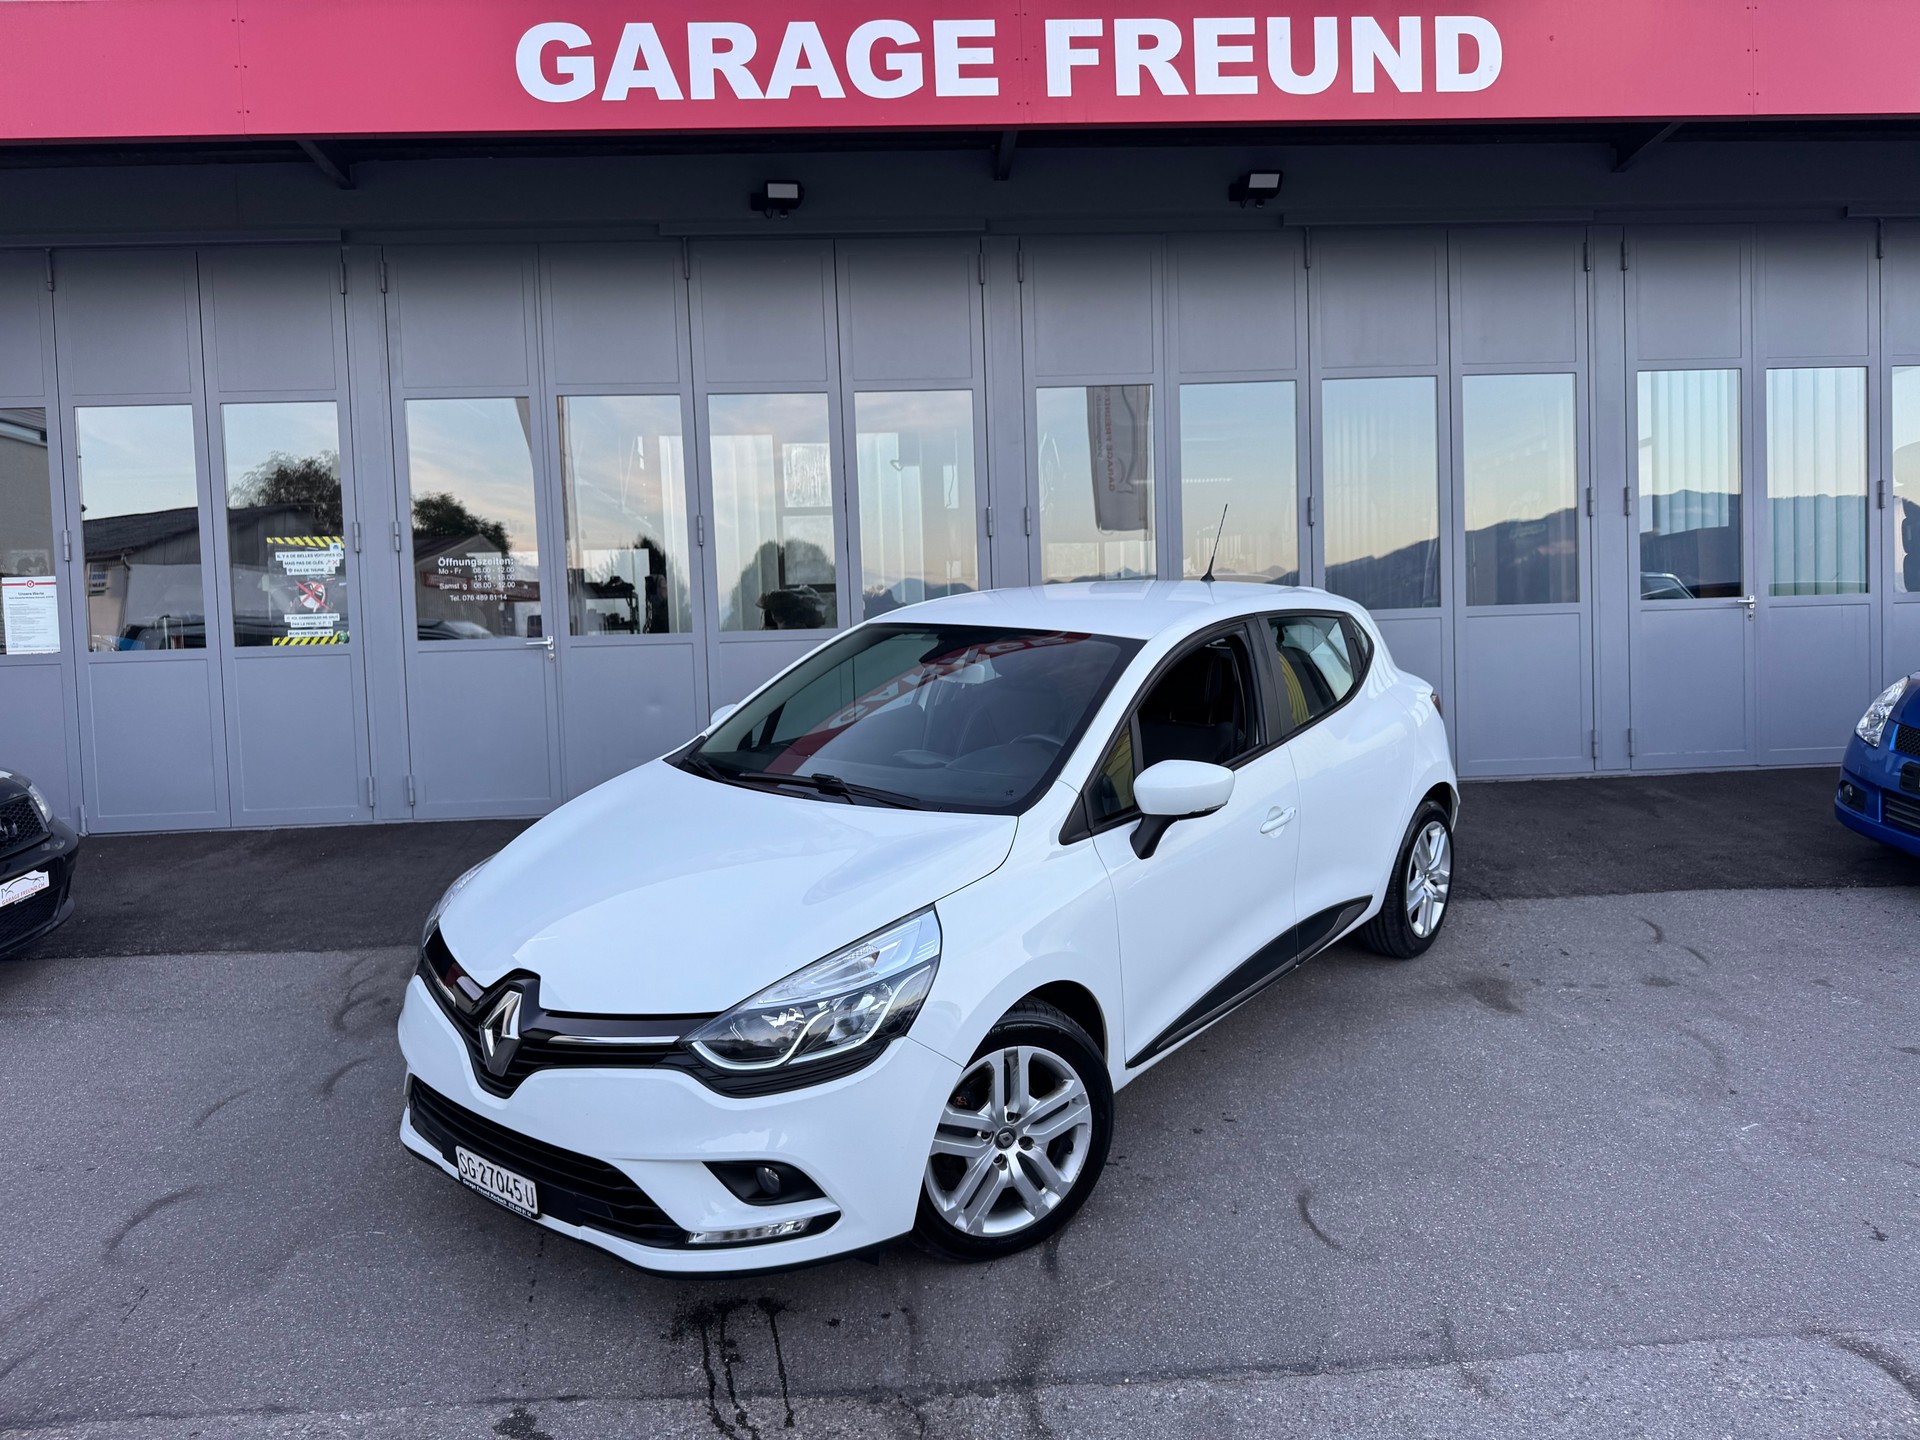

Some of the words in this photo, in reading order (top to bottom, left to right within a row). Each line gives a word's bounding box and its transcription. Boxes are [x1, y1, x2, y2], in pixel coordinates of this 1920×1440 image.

[516, 19, 999, 102] GARAGE
[1045, 16, 1503, 97] FREUND
[437, 556, 514, 568] Öffnungszeiten:
[438, 567, 449, 575] Mo
[439, 582, 468, 590] Samstg
